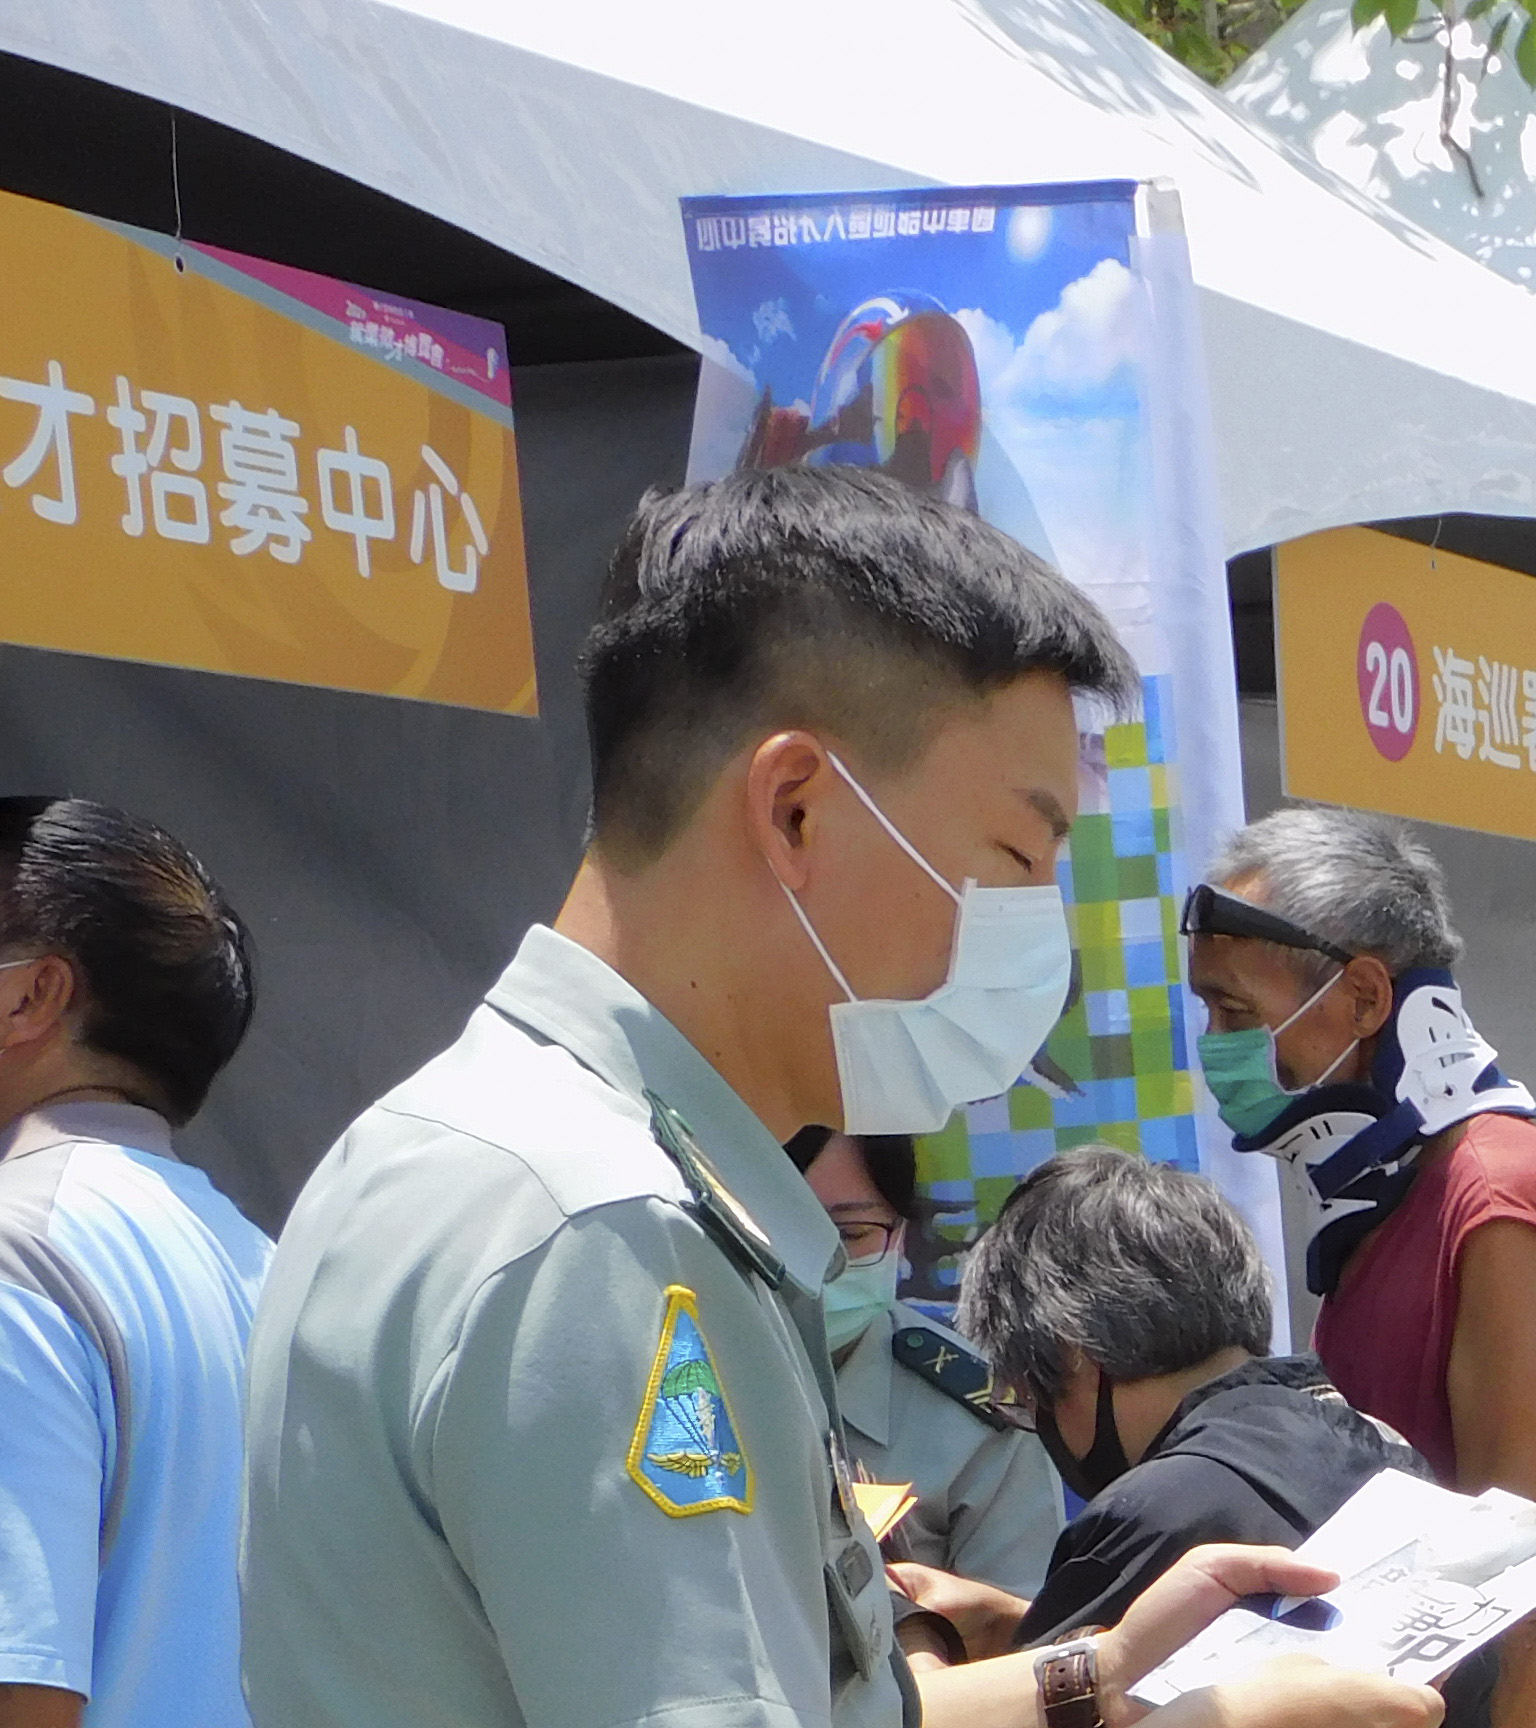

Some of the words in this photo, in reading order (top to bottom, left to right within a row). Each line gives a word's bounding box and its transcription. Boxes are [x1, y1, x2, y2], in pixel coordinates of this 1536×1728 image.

[0, 360, 490, 593] 才招募中心
[1365, 640, 1414, 735] 20
